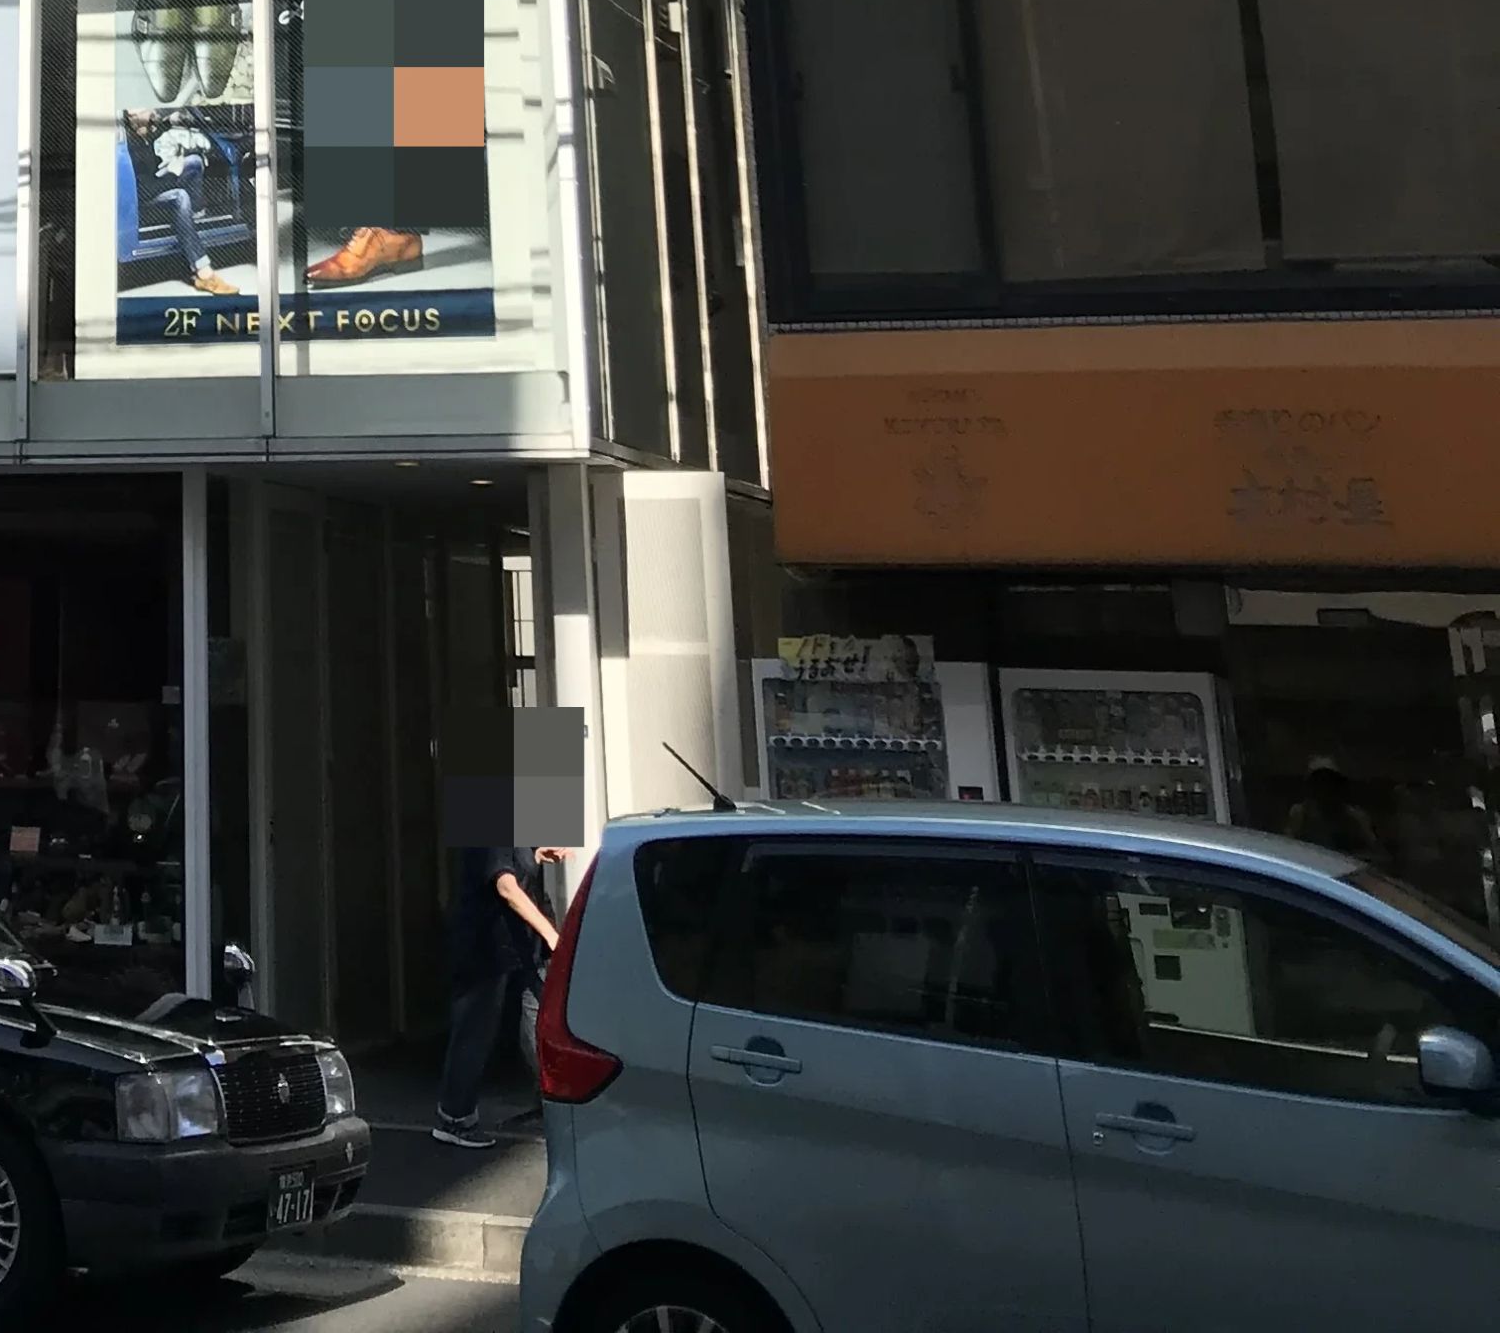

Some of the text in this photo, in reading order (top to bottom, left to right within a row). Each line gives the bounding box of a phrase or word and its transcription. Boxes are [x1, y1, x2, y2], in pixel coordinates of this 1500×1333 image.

[164, 308, 440, 336] 2F NEXT FOCUS
